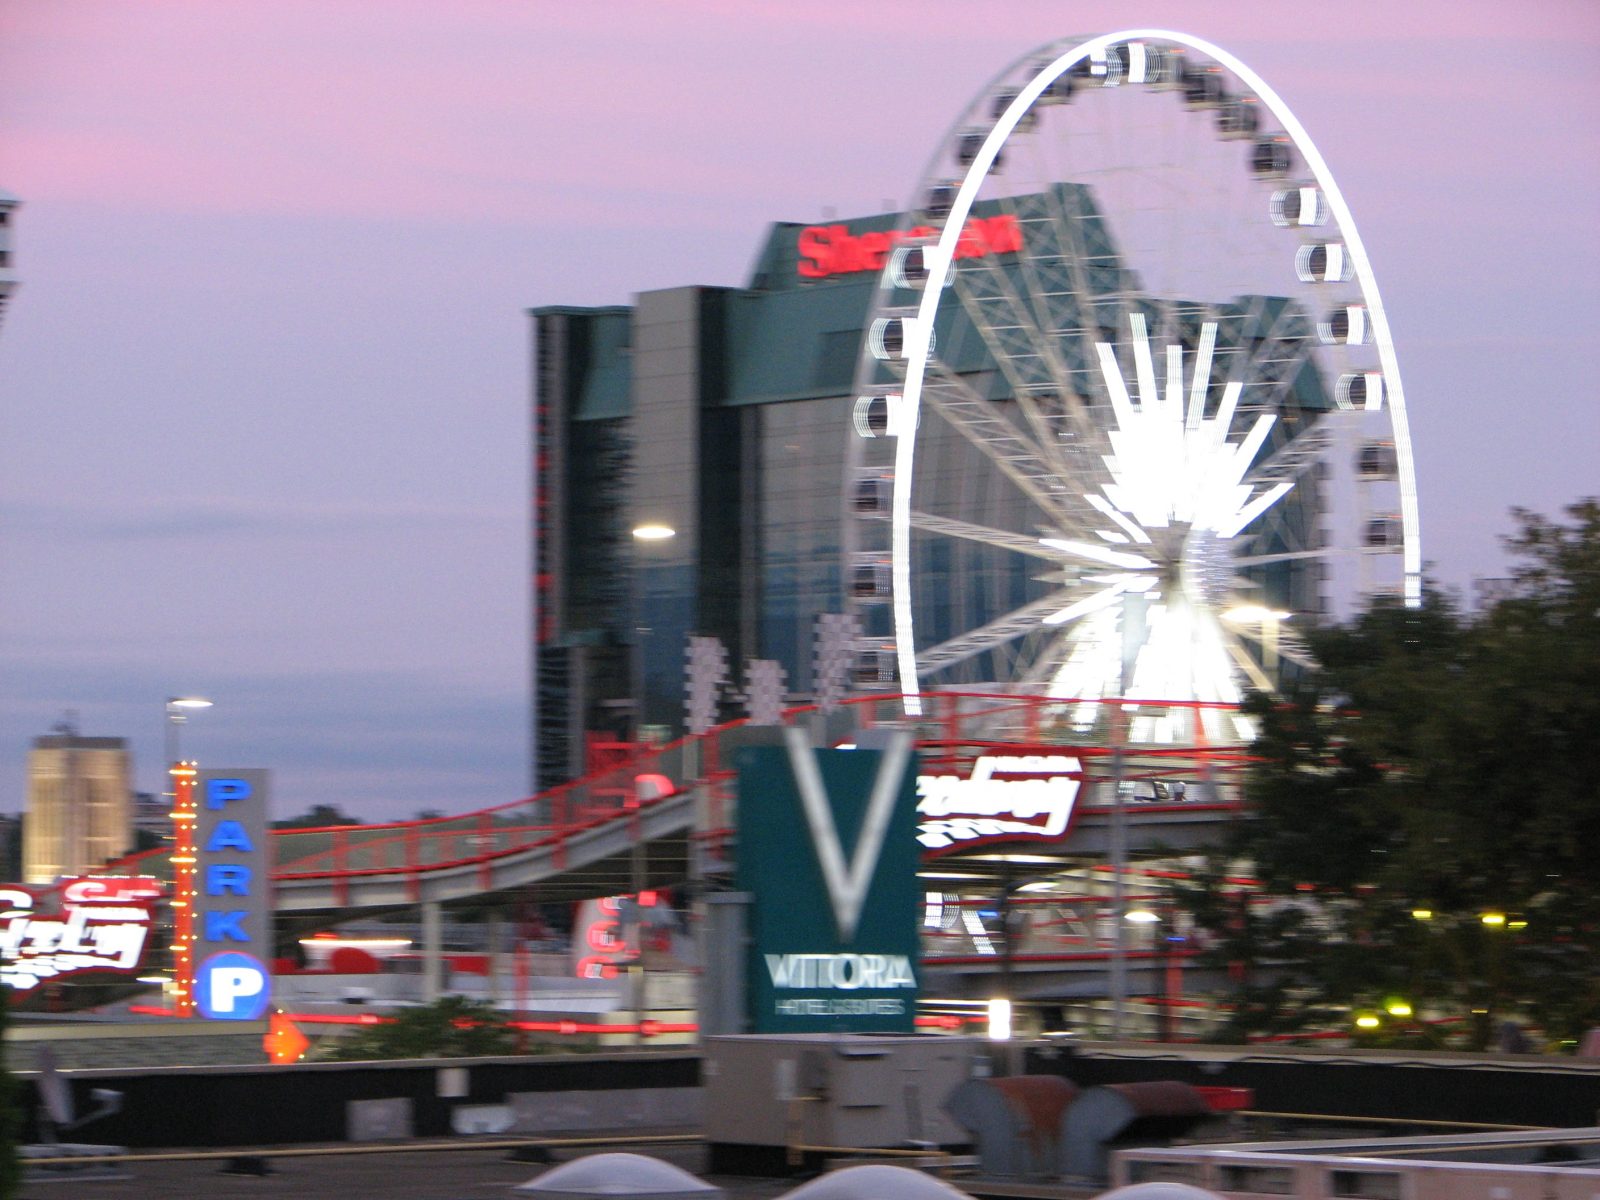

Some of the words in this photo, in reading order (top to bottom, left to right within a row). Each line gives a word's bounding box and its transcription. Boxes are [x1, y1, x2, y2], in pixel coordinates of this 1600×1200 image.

[206, 778, 252, 942] PARK
[785, 726, 913, 938] V
[209, 966, 264, 1012] P
